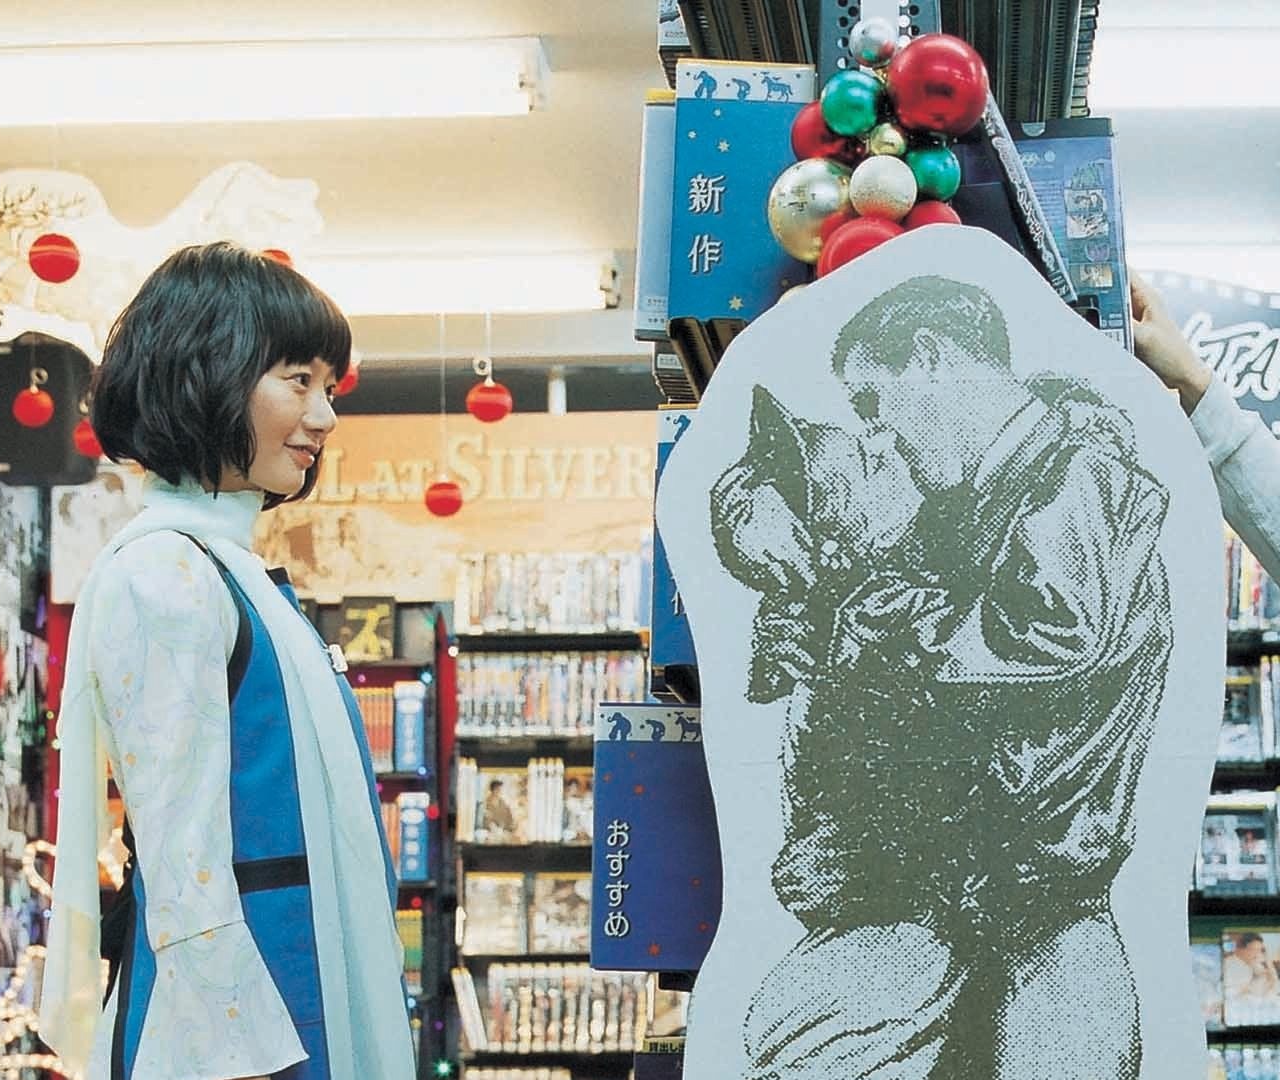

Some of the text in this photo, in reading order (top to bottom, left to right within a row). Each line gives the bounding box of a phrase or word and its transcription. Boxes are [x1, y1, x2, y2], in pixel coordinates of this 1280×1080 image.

[688, 172, 727, 275] 新作
[370, 458, 436, 502] AT
[449, 432, 653, 502] SILVER
[603, 818, 632, 938] おすすめ
